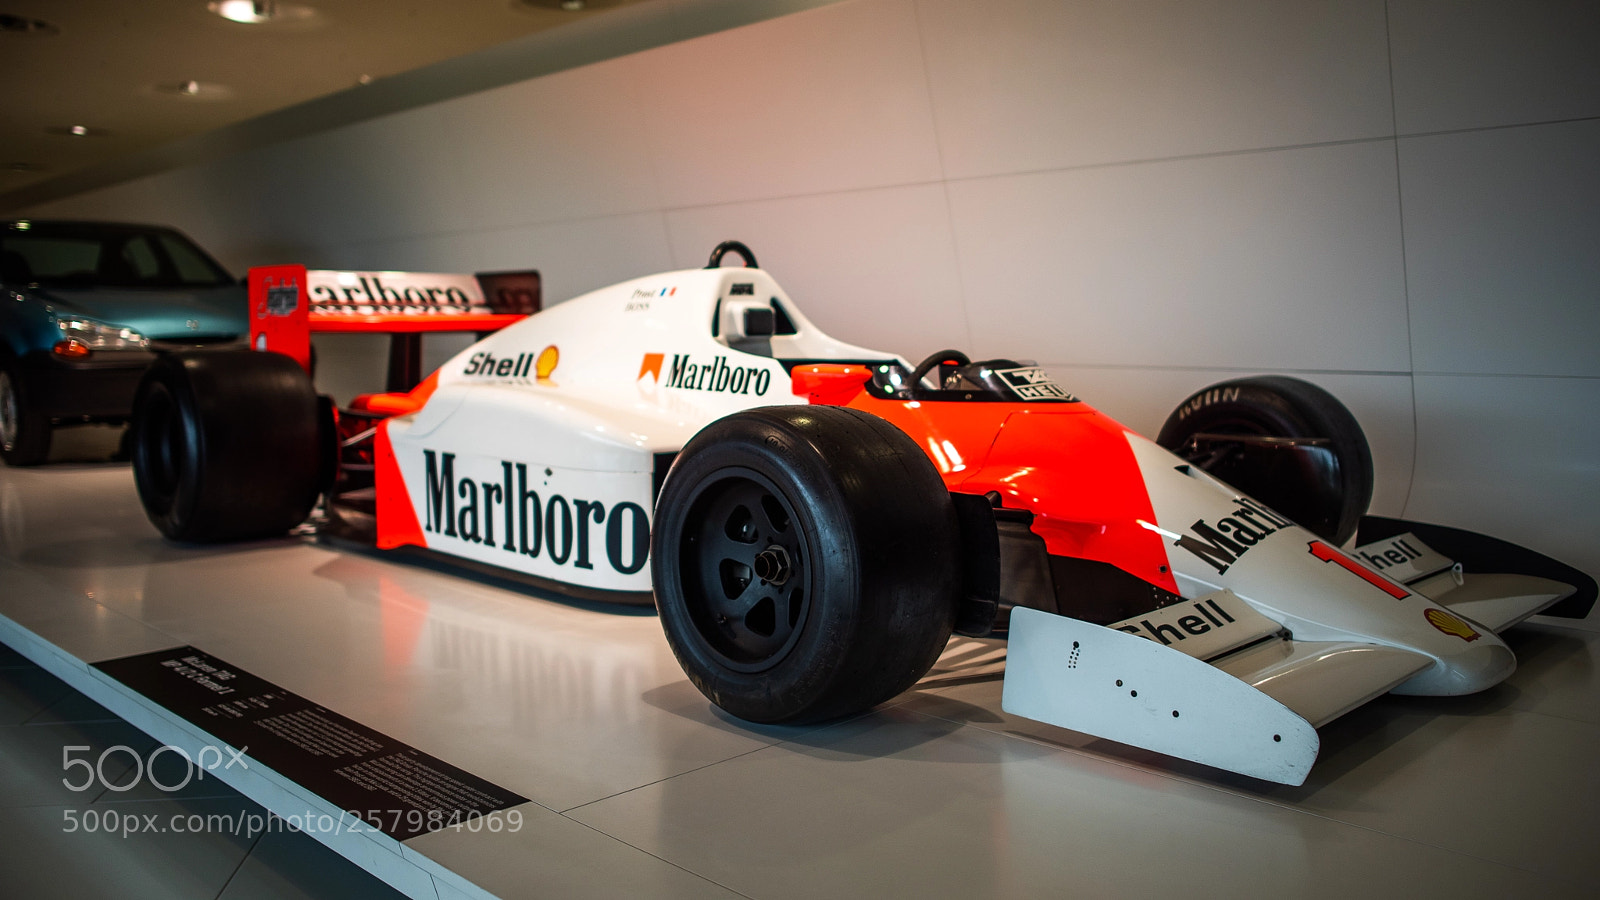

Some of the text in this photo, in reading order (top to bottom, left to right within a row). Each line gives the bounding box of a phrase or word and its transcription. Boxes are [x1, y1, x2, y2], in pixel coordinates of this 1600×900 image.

[310, 276, 472, 308] arlboro
[463, 352, 534, 377] Shell
[665, 353, 771, 396] Marlboro
[1012, 369, 1054, 384] TA
[423, 448, 650, 575] Marlboro
[1308, 540, 1412, 600] 1
[1352, 539, 1422, 570] hell
